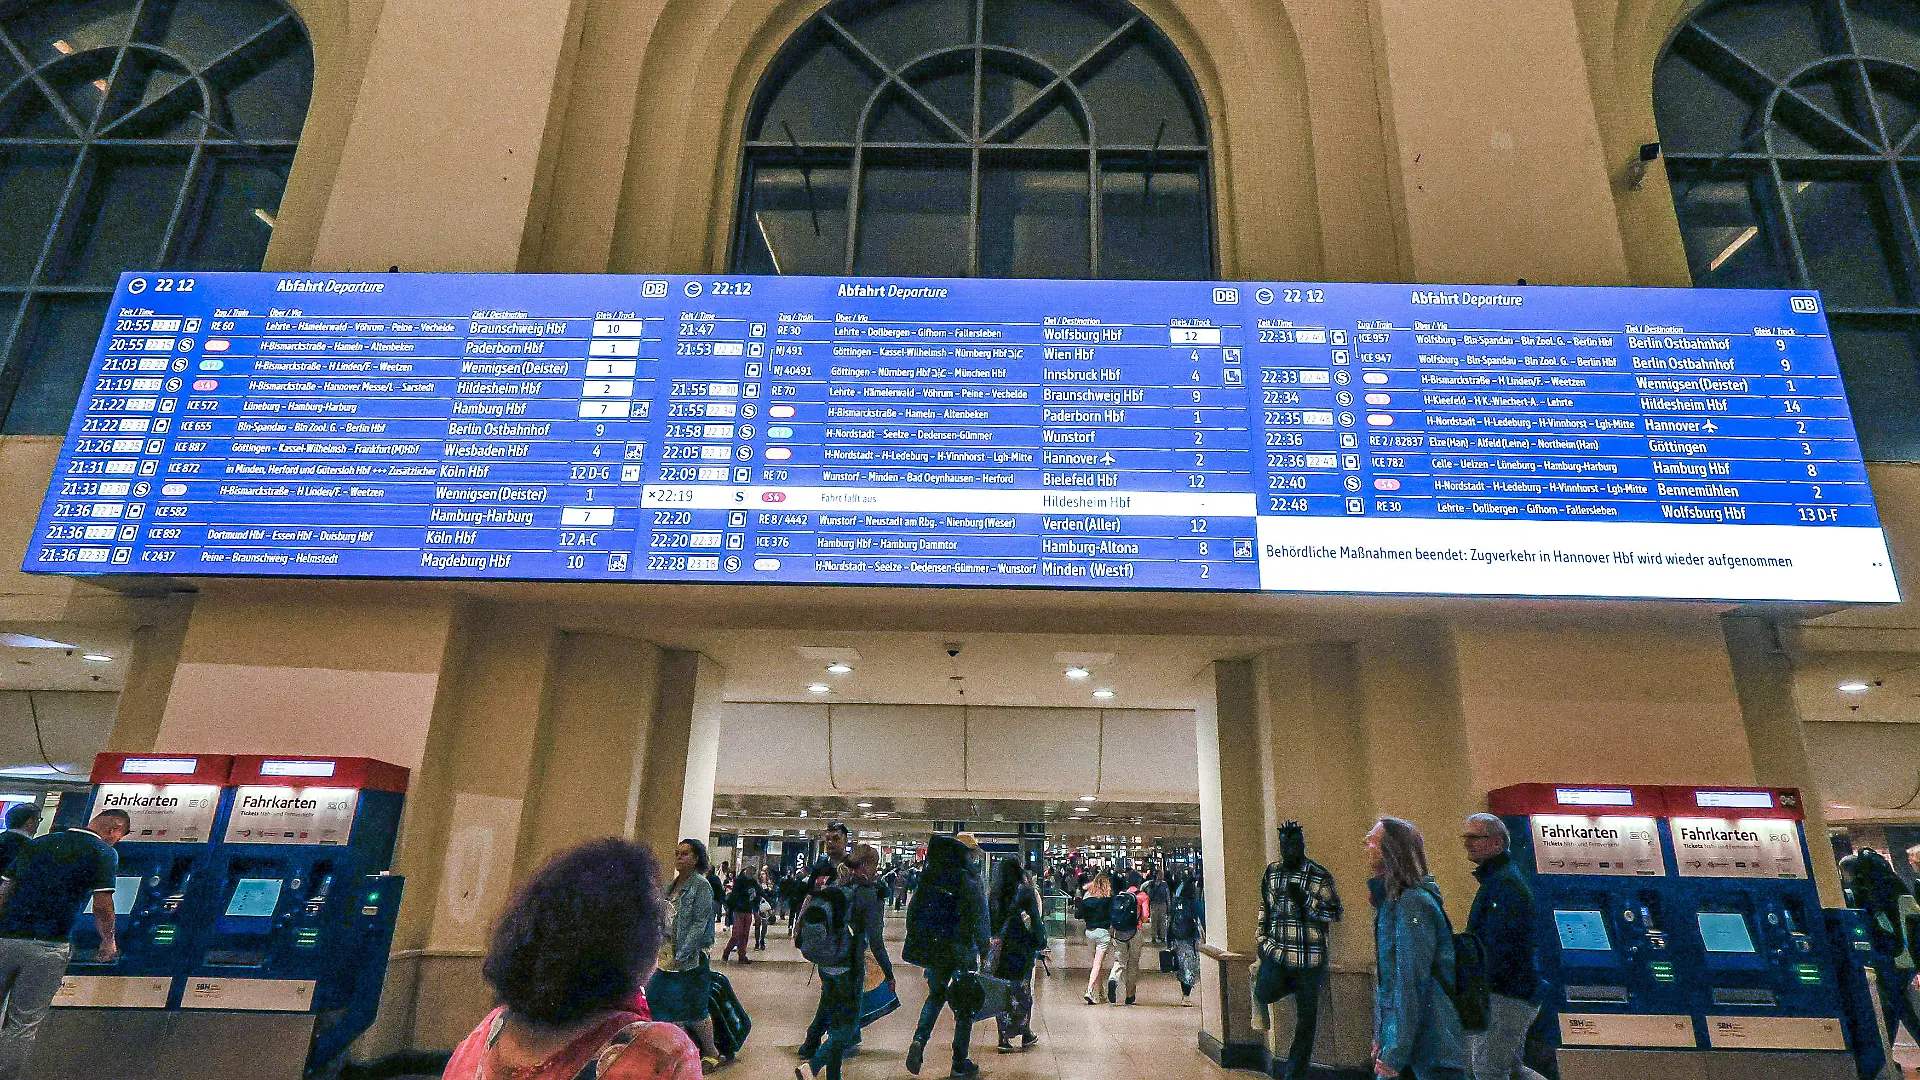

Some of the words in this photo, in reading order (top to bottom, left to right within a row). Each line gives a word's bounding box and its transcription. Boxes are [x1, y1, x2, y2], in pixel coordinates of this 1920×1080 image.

[155, 279, 171, 292] 22
[177, 280, 194, 292] 12
[277, 280, 323, 292] Abfahrt
[325, 281, 384, 294] Departure
[644, 282, 666, 296] DB
[712, 283, 751, 295] 22:12
[838, 284, 885, 297] Abfahrt
[888, 285, 947, 299] Departure
[1215, 289, 1237, 303] DB
[1284, 290, 1301, 302] 22
[1307, 291, 1324, 302] 12
[1412, 292, 1459, 304] Abfahrt
[1462, 293, 1523, 307] Departure
[1793, 299, 1816, 311] DB
[115, 320, 150, 331] 20:55
[470, 323, 543, 335] Braunschweig
[547, 323, 566, 333] Hbf
[607, 324, 619, 333] 10
[679, 324, 714, 335] 21:47
[778, 326, 787, 335] RE
[790, 326, 801, 335] 30
[1044, 330, 1099, 342] Wolfsburg
[1103, 330, 1122, 341] Hbf
[1259, 332, 1294, 342] 22:31
[109, 339, 144, 350] 20:55
[466, 343, 521, 354] Paderborn
[524, 343, 544, 353] Hbf
[677, 344, 711, 355] 21:53
[1629, 338, 1662, 349] Berlin
[1665, 339, 1729, 350] Ostbahnhof
[776, 346, 785, 355] NJ
[787, 347, 802, 355] 491
[1044, 349, 1071, 360] Wien
[1075, 350, 1094, 360] Hbf
[102, 360, 137, 370] 21:03
[1634, 358, 1666, 369] Berlin
[1669, 359, 1735, 370] Ostbahnhof
[774, 367, 783, 375] NJ
[784, 367, 811, 375] 40491
[1044, 369, 1097, 381] Innsbruck
[1101, 369, 1121, 381] Hbf
[1262, 372, 1297, 382] 22:33
[96, 379, 131, 390] 21:19
[458, 382, 517, 394] Hildesheim
[519, 383, 542, 394] Hbf
[671, 384, 706, 395] 21:55
[1044, 390, 1121, 402] Braunschweig
[1124, 391, 1143, 402] Hbf
[1263, 392, 1299, 403] 22:34
[89, 400, 124, 410] 21:22
[453, 403, 502, 415] Hamburg
[506, 403, 526, 413] Hbf
[669, 405, 704, 416] 21:55
[1641, 399, 1704, 411] Hildesheim
[1708, 400, 1727, 411] Hbf
[1784, 401, 1801, 412] 14
[1044, 410, 1100, 421] Paderborn
[1104, 411, 1125, 422] Hbf
[1265, 413, 1300, 424] 22:35
[82, 420, 117, 431] 21:22
[449, 424, 481, 435] Berlin
[485, 424, 550, 435] Ostbahnhof
[1645, 419, 1699, 431] Hannover
[666, 427, 701, 437] 21:58
[826, 430, 875, 439] H-Nordstadt
[884, 431, 909, 439] Seelze
[918, 431, 992, 440] Dedensen-Gümmer
[1043, 431, 1095, 442] Wunstorf
[1266, 433, 1302, 445] 22:36
[75, 441, 111, 452] 21:26
[445, 445, 504, 456] Wiesbaden
[508, 445, 528, 456] Hbf
[1649, 441, 1707, 455] Göttingen
[662, 448, 698, 459] 22:05
[1044, 453, 1098, 464] Hannover
[68, 462, 104, 473] 21:31
[1268, 456, 1304, 467] 22:36
[1372, 459, 1385, 467] ICE
[1388, 459, 1404, 468] 782
[1432, 459, 1452, 468] Celle
[1460, 460, 1488, 469] Uelzen
[1497, 460, 1535, 471] Lüneburg
[1544, 461, 1617, 473] Hamburg-Harburg
[440, 466, 464, 476] Köln
[468, 466, 490, 477] Hbf
[660, 469, 696, 480] 22:09
[1654, 462, 1707, 477] Hamburg
[1709, 463, 1730, 474] Hbf
[823, 472, 859, 481] Wunstorf
[869, 473, 898, 481] Minden
[907, 473, 922, 482] Bad
[924, 474, 973, 484] Oeynhausen
[982, 474, 1014, 483] Herford
[1044, 475, 1093, 487] Bielefeld
[1097, 475, 1117, 487] Hbf
[1269, 477, 1306, 489] 22:40
[61, 483, 96, 494] 21:33
[1658, 484, 1739, 497] Bennemühlen
[1044, 496, 1107, 508] Hildesheim
[1111, 497, 1130, 508] Hbf
[1271, 499, 1307, 510] 22:48
[54, 505, 90, 516] 21:36
[431, 508, 533, 525] Hamburg-Harburg
[1662, 505, 1722, 521] Wolfsburg
[1725, 508, 1746, 519] Hbf
[654, 512, 690, 524] 22:20
[1191, 520, 1207, 532] 12
[46, 527, 82, 538] 21:36
[208, 531, 247, 540] Dortmund
[250, 531, 264, 540] Hbf
[272, 531, 296, 540] Essen
[426, 531, 453, 543] Köln
[456, 531, 477, 543] Hbf
[651, 535, 688, 546] 22:20
[756, 537, 770, 547] ICE
[772, 537, 789, 547] 376
[1043, 541, 1138, 556] Hamburg-Altona
[39, 549, 75, 561] 21:36
[202, 553, 224, 562] Peine
[232, 553, 288, 565] Braunschweig
[296, 554, 338, 563] Helmstedt
[422, 553, 486, 569] Magdeburg
[490, 555, 511, 567] Hbf
[1267, 545, 1336, 558] Behördliche
[1340, 546, 1412, 560] Maßnahmen
[1415, 549, 1467, 561] beendet:
[1471, 549, 1535, 564] Zugverkehr
[1540, 551, 1550, 562] in
[1554, 551, 1609, 564] Hannover
[1614, 552, 1634, 564] Hbf
[1638, 553, 1662, 564] wird
[1665, 553, 1704, 566] wieder
[1708, 555, 1792, 568] aufgenommen
[648, 557, 684, 569] 22:28
[1043, 563, 1086, 576] Minden
[1090, 564, 1134, 578] (Westf)
[104, 794, 178, 807] Fahrkarten
[243, 797, 316, 809] Fahrkarten
[1542, 825, 1618, 839] Fahrkarten
[1681, 828, 1758, 841] Fahrkarten
